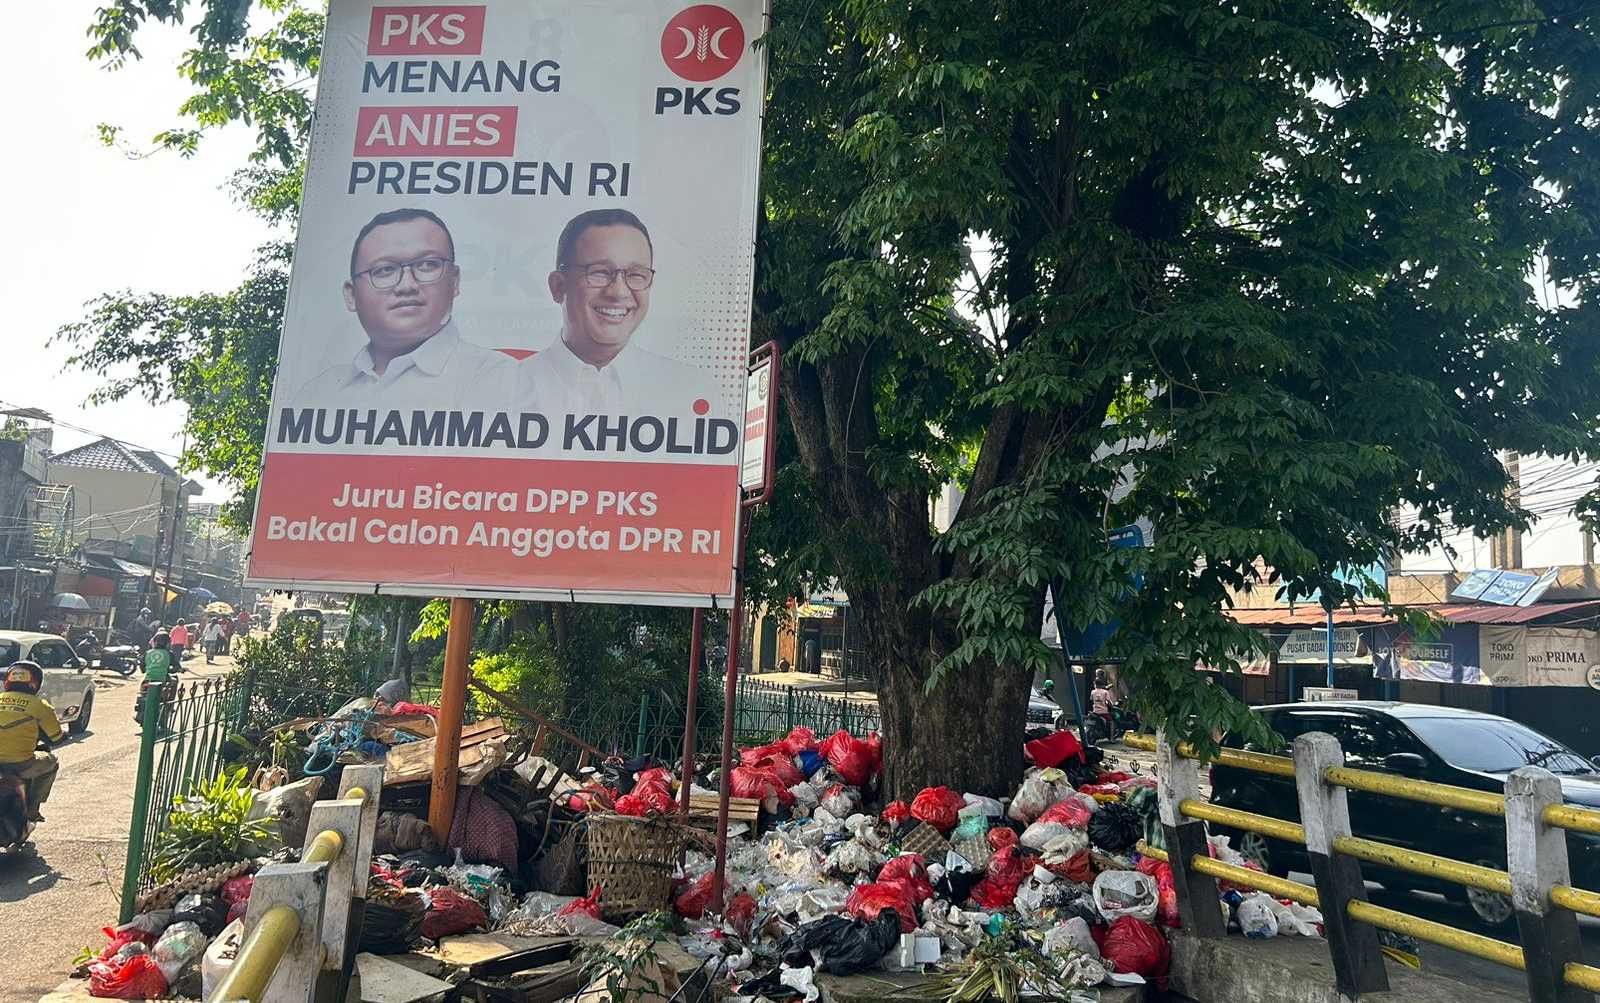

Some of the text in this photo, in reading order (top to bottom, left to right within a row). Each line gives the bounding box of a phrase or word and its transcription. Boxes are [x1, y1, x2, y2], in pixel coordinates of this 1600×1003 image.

[381, 13, 466, 47] PKS
[361, 59, 561, 94] MENANG
[655, 86, 741, 116] PKS
[364, 113, 502, 147] ANIES
[348, 160, 631, 198] PRESIDEN RI
[276, 406, 549, 450] MUHAMMAD
[332, 482, 659, 517] Juru Bicara DPP PKS
[266, 515, 722, 559] Bakal Calon Anggota DPR RI
[1491, 643, 1514, 652] TOKO
[1546, 651, 1586, 663] PRIMA
